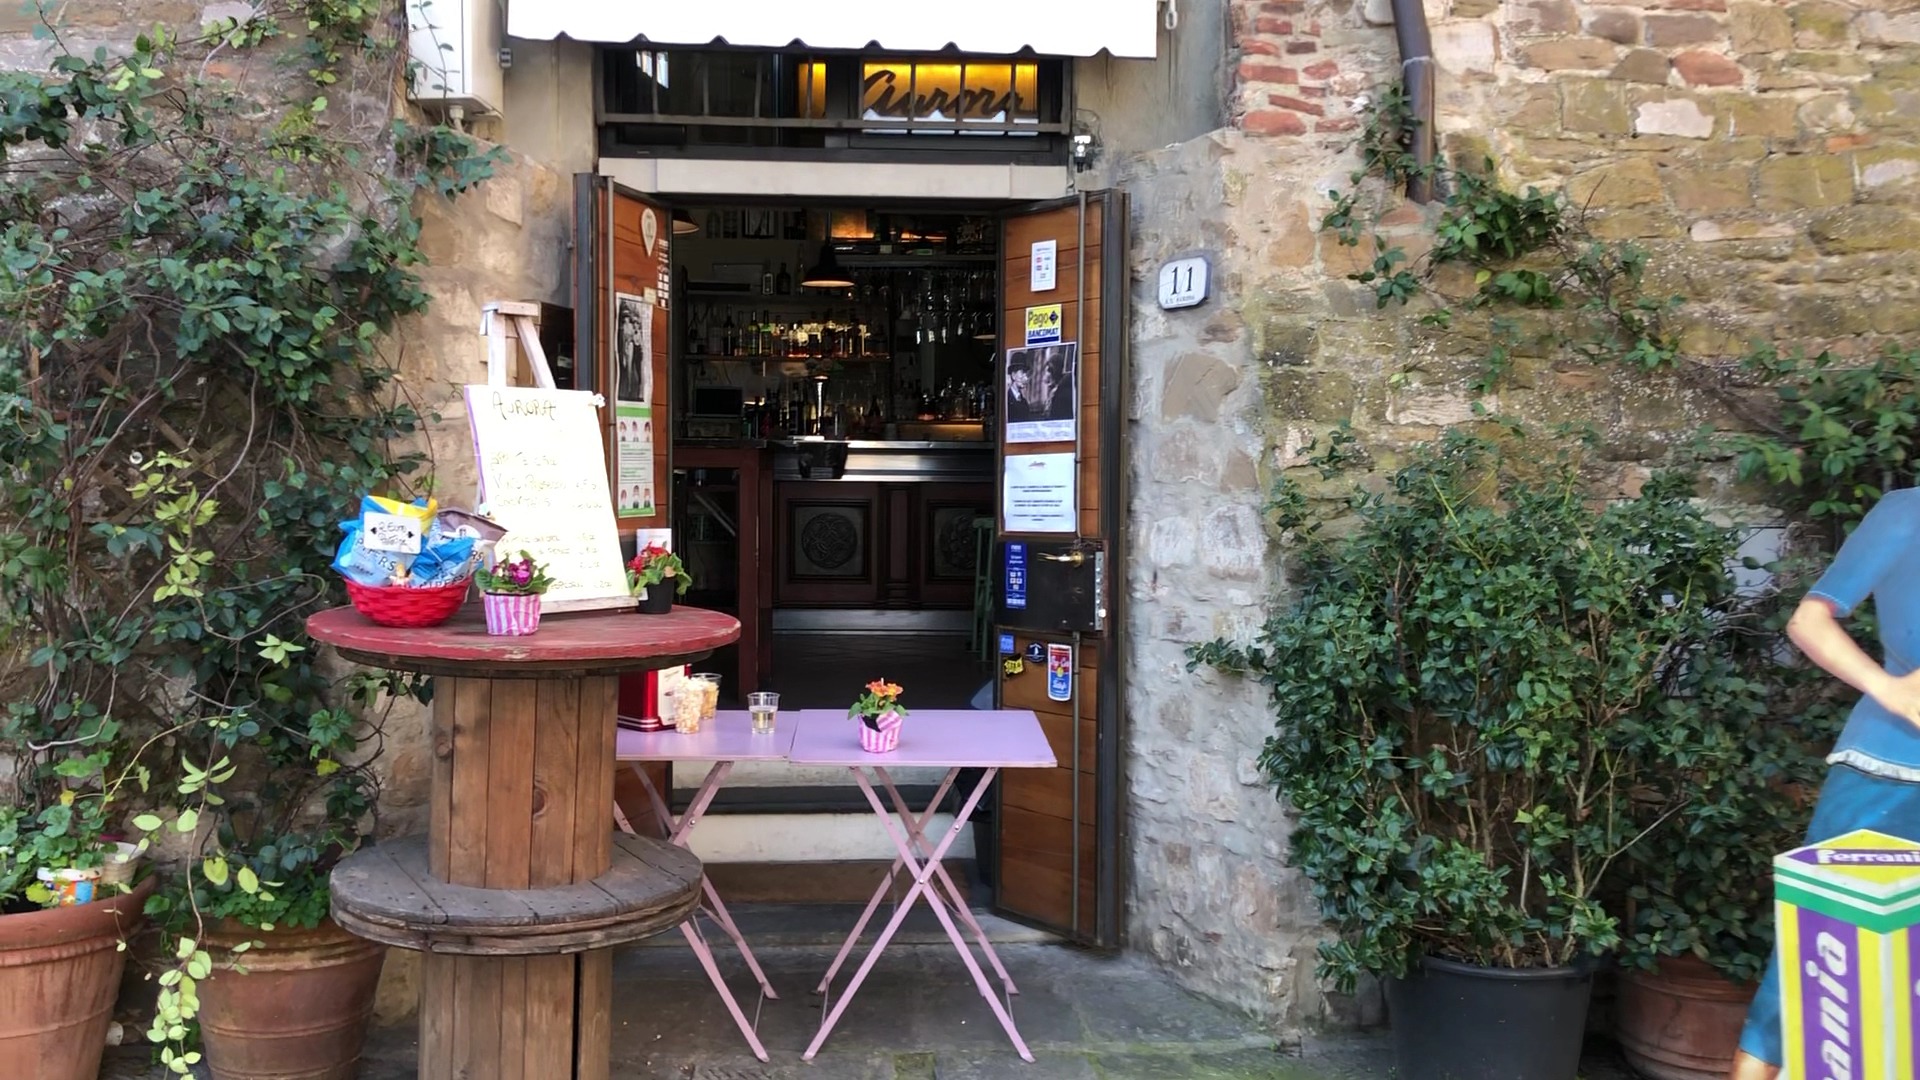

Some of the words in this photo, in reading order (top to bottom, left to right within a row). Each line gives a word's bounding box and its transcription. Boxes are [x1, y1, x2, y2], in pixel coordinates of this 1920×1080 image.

[1171, 265, 1193, 295] 11
[1027, 311, 1048, 327] Pago
[1805, 931, 1852, 1080] ania
